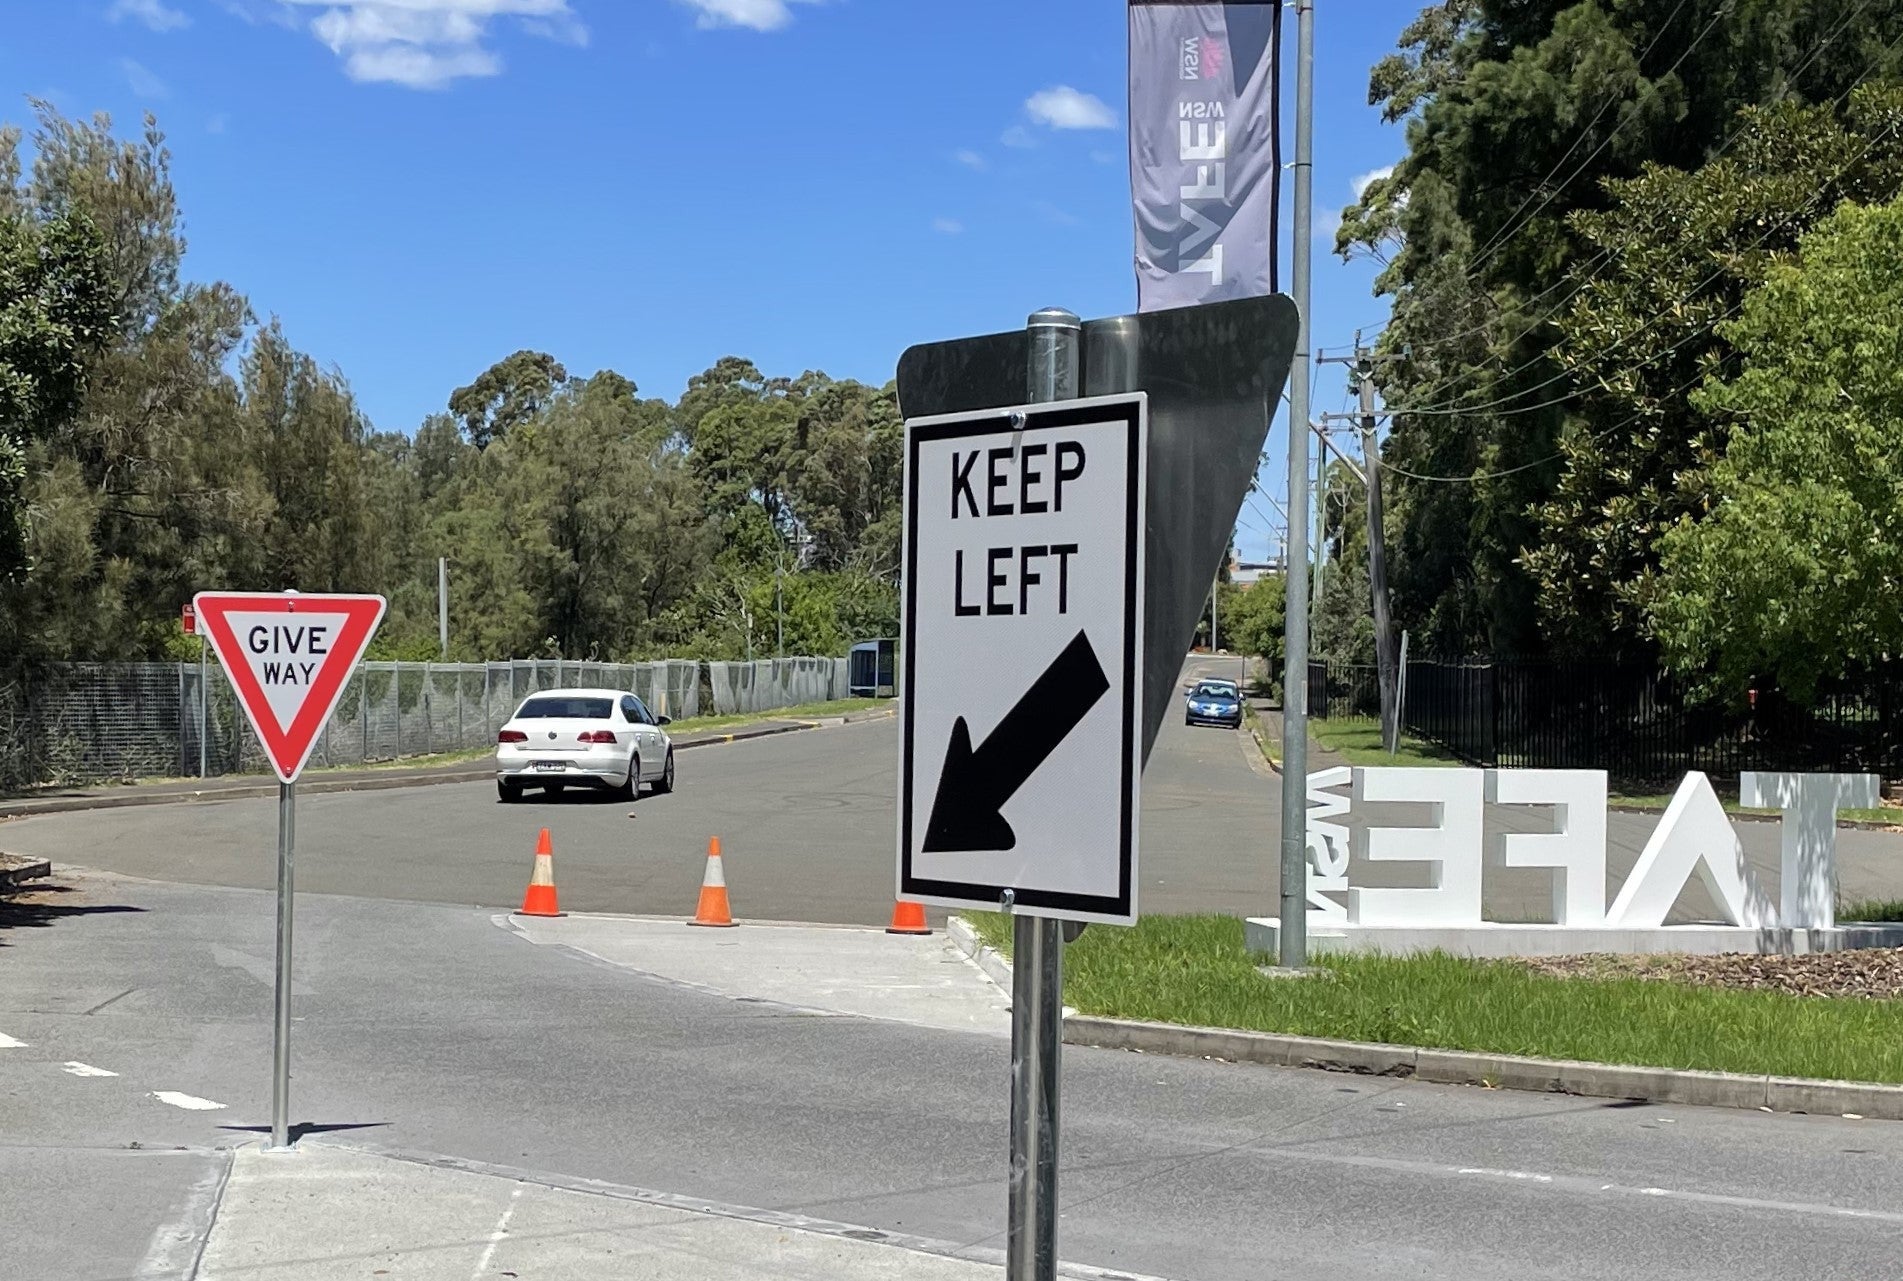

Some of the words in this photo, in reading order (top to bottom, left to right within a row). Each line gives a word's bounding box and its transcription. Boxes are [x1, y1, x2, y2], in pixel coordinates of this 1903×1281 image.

[950, 440, 1087, 519] KEEP
[954, 543, 1079, 617] LEFT
[248, 625, 327, 654] GIVE
[263, 662, 316, 685] WAY
